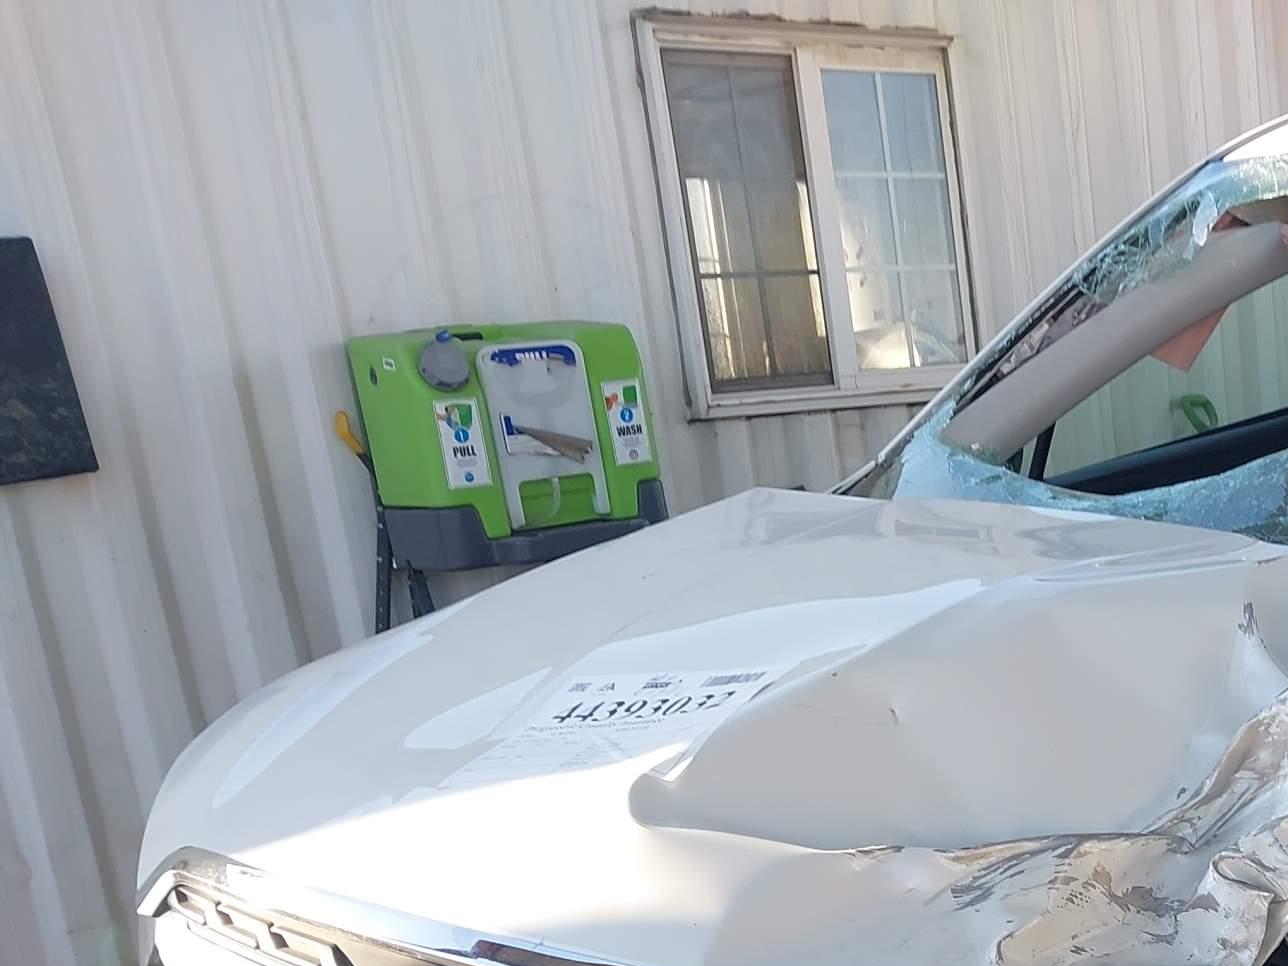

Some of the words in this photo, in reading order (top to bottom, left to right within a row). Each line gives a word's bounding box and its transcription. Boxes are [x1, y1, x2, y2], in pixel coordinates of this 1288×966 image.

[616, 424, 643, 437] WASH
[452, 445, 478, 459] PULL
[552, 690, 737, 723] 44393032
